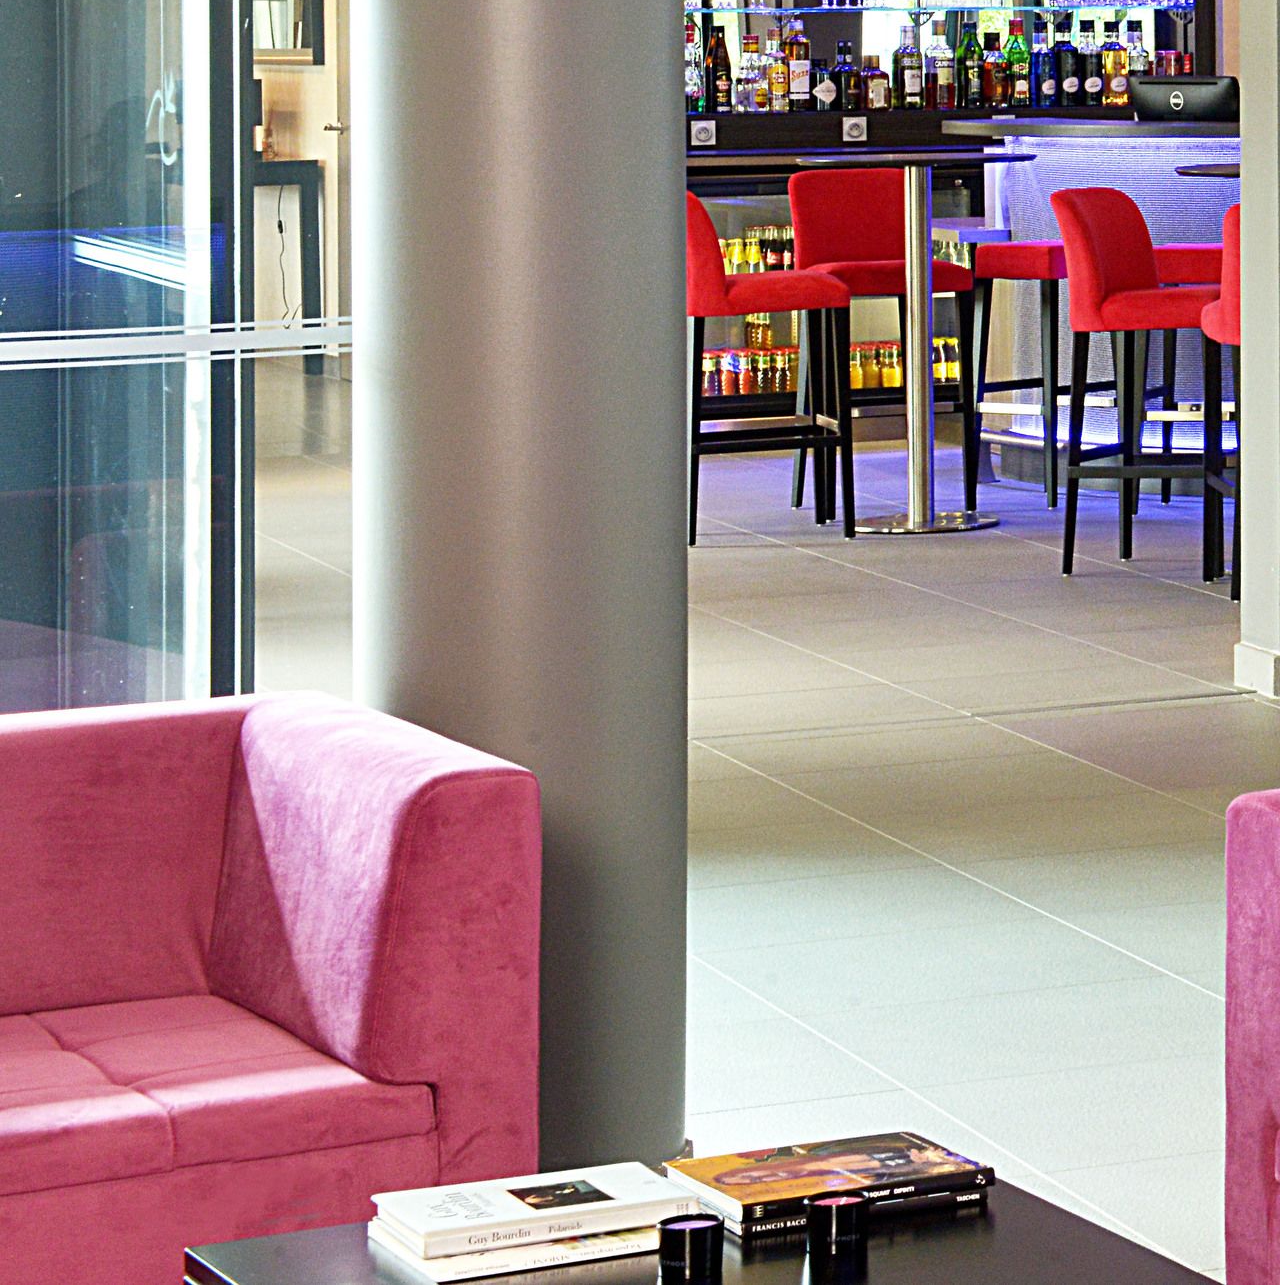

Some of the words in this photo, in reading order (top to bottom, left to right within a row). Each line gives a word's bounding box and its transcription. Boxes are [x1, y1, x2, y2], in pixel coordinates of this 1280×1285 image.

[752, 1220, 785, 1233] FRANCIS
[786, 1217, 808, 1229] BACO
[468, 1234, 489, 1247] Guy
[491, 1227, 532, 1243] Bourdin
